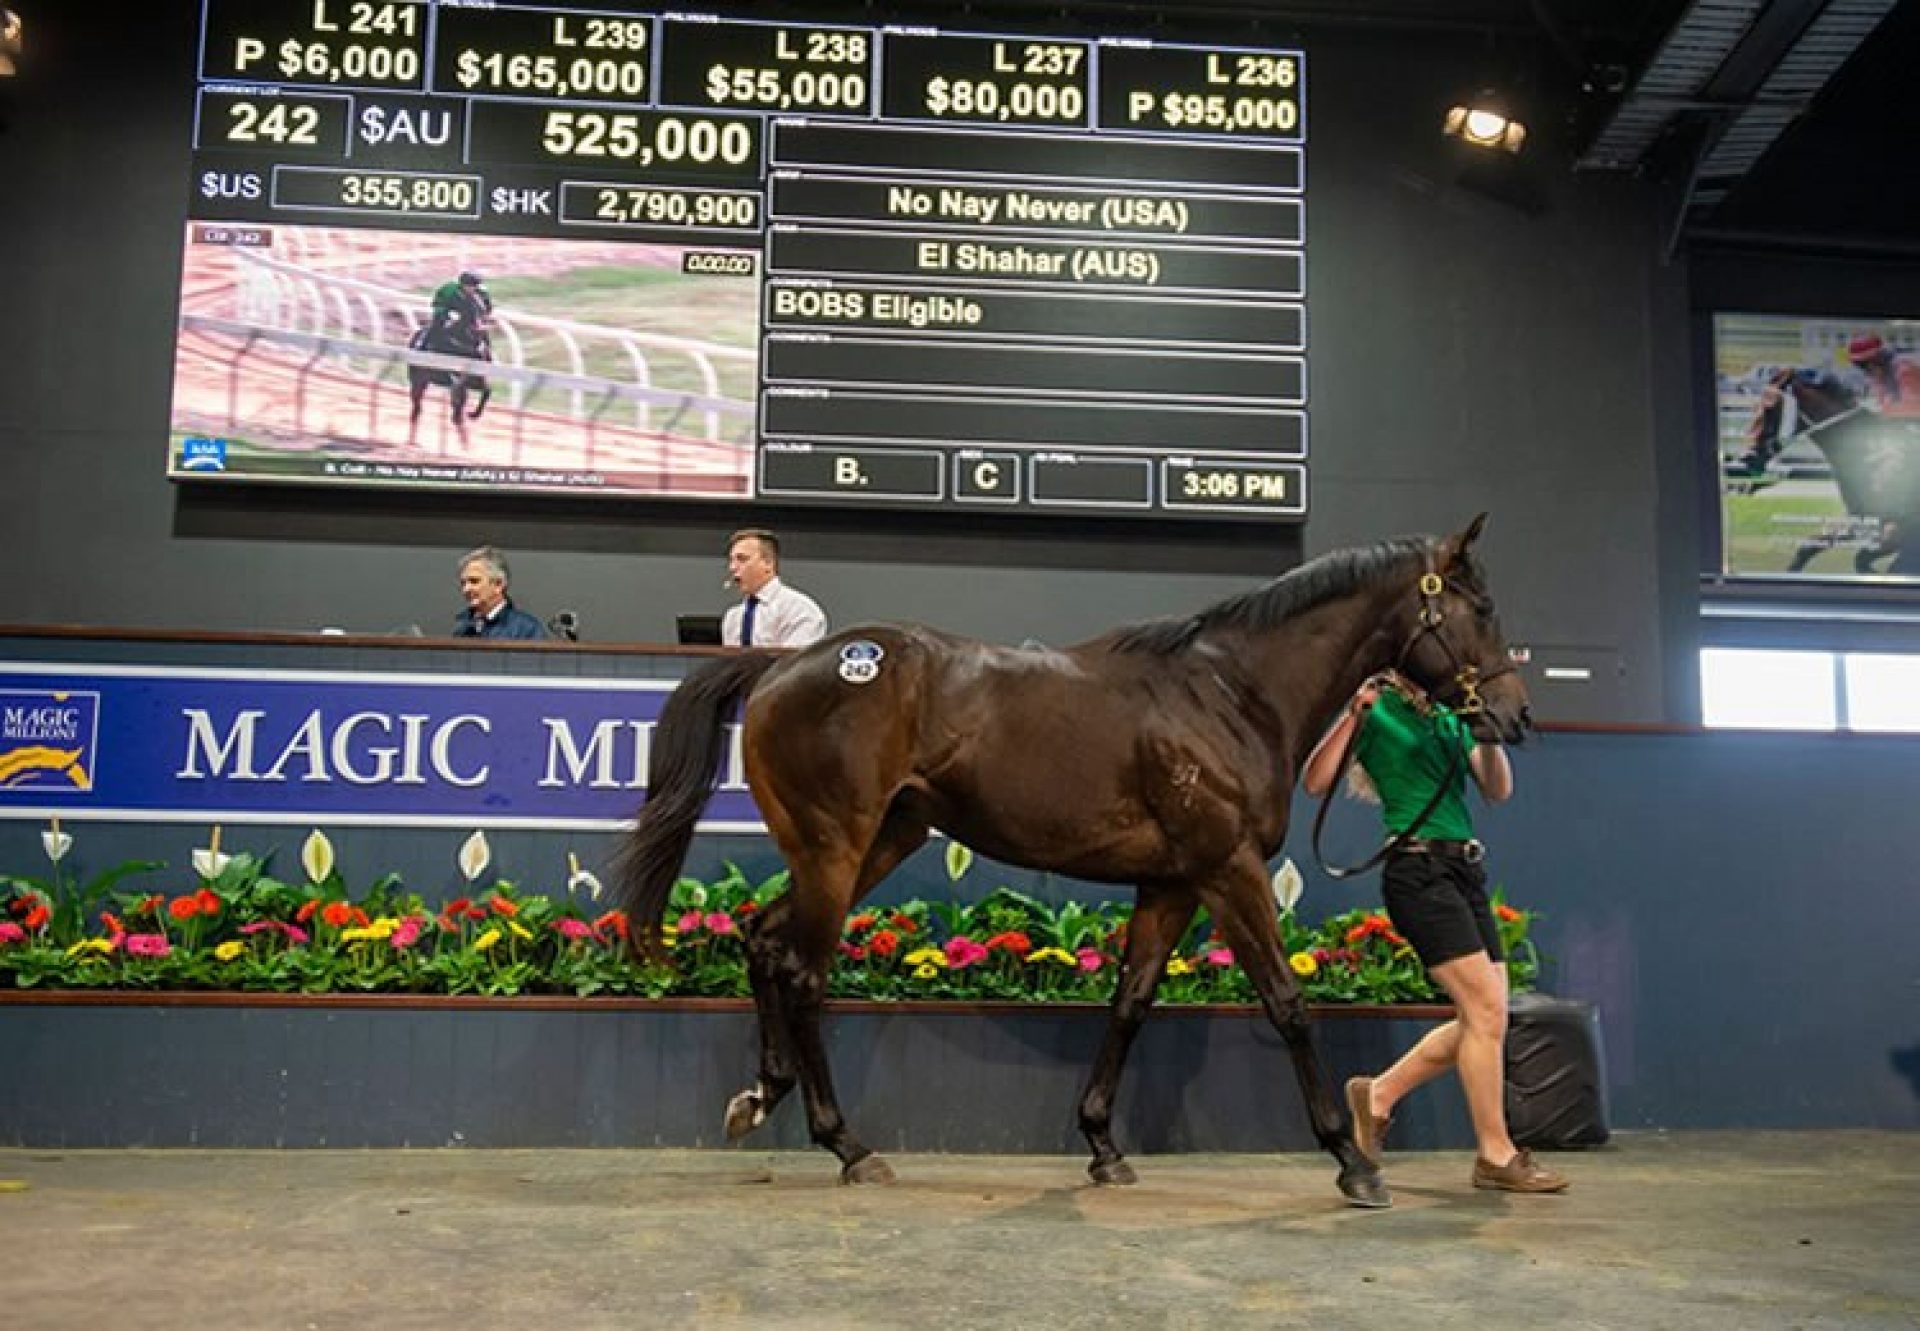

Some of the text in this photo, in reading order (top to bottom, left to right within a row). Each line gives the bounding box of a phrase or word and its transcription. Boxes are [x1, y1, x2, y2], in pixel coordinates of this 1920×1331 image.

[315, 0, 418, 36] L 241
[555, 18, 645, 49] L 239
[236, 38, 417, 82] P $6,000
[778, 31, 865, 64] L 238
[996, 44, 1083, 74] L 237
[456, 49, 643, 95] $165,000
[706, 64, 865, 109] $55,000
[1208, 56, 1295, 87] L 236
[926, 77, 1082, 121] $80,000
[1129, 92, 1295, 132] P $95,000
[228, 103, 318, 144] 242
[361, 105, 450, 145] $AU
[543, 112, 750, 166] 525,000
[202, 172, 261, 198] $US
[342, 177, 471, 211] 355,800
[492, 187, 550, 213] $HK
[597, 190, 754, 226] 2,790,900
[890, 187, 1188, 234] No Nay Never (USA)
[919, 242, 1161, 286] El Shahar (AUS)
[776, 288, 985, 327] BOBS Eligible
[837, 458, 868, 484] B.
[975, 463, 998, 489] C
[1185, 471, 1285, 499] 3:06 PM
[847, 662, 870, 677] 242
[5, 709, 79, 727] MAGIC
[176, 709, 489, 786] MAGIC
